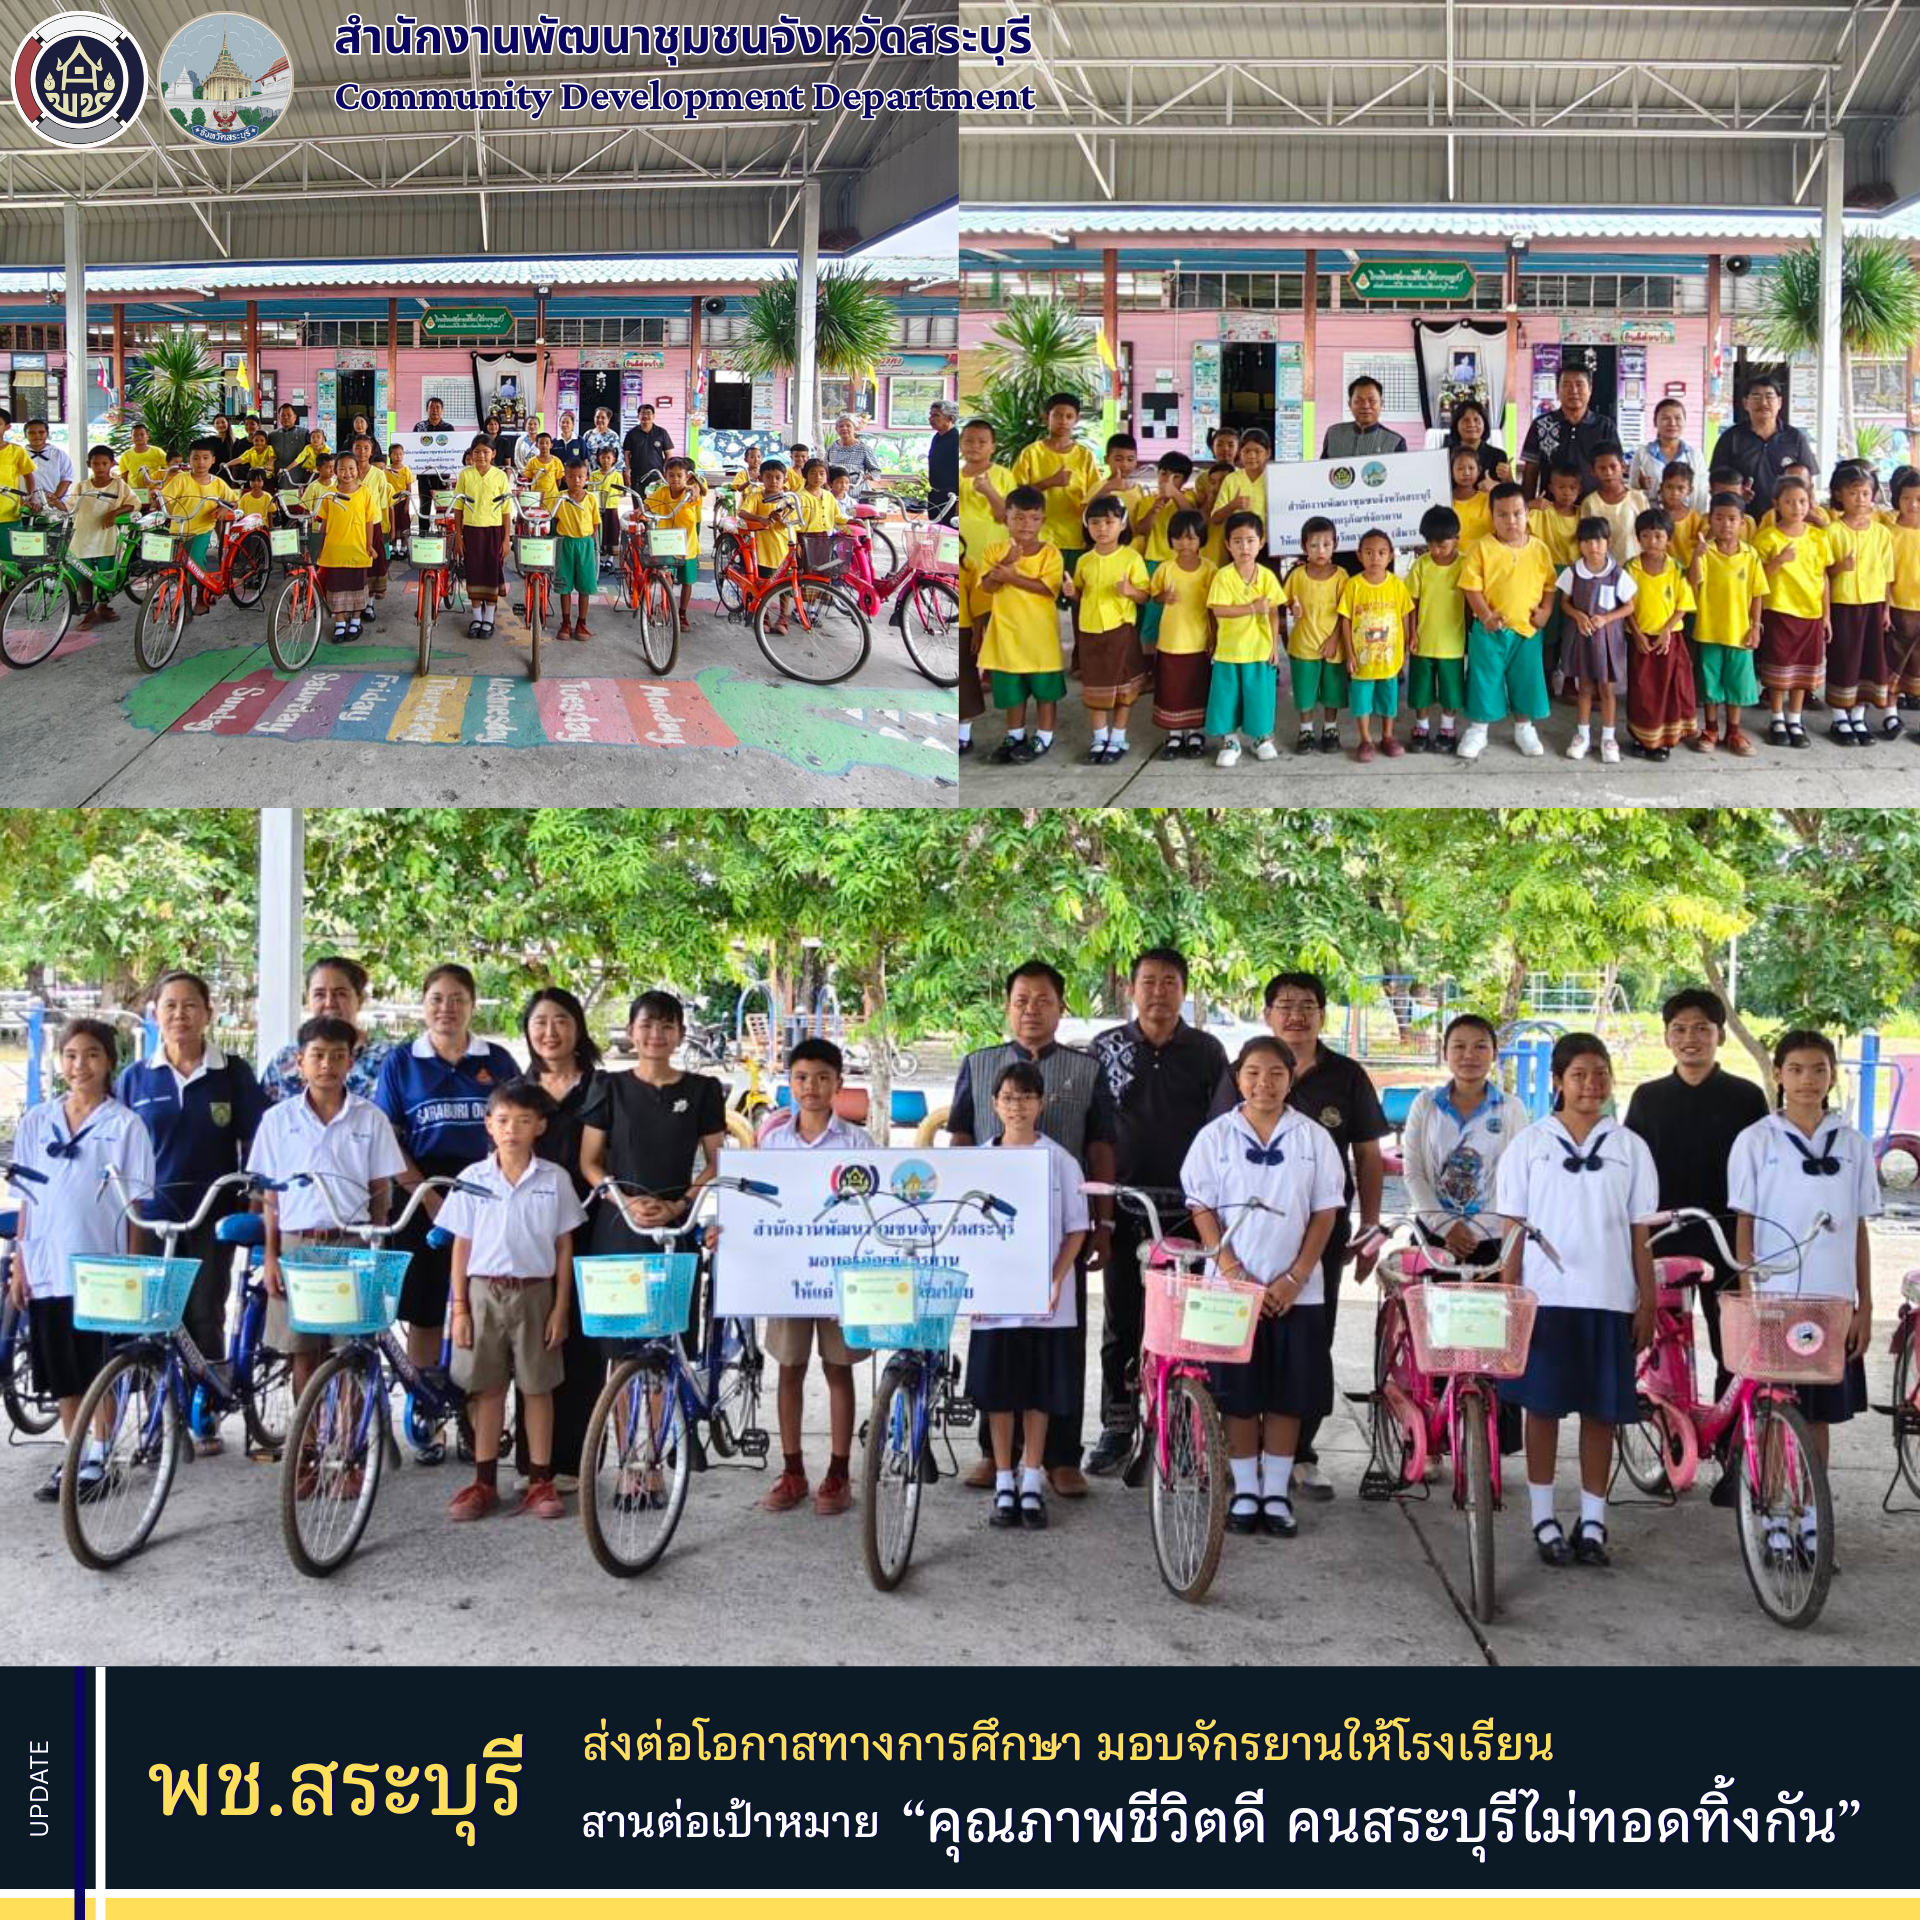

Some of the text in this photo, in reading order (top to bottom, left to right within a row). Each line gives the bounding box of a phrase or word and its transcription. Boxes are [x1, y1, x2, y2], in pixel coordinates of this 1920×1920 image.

[72, 558, 93, 578] ACTION
[187, 559, 206, 579] ACTION
[182, 687, 265, 732] Sunday
[255, 672, 341, 734] Saturday
[338, 674, 400, 722] Friday
[394, 676, 458, 743] Thursday
[475, 677, 518, 744] Wednesday
[555, 681, 600, 743] Tuesday
[639, 684, 687, 745] Monday
[416, 1102, 469, 1124] SARABURI
